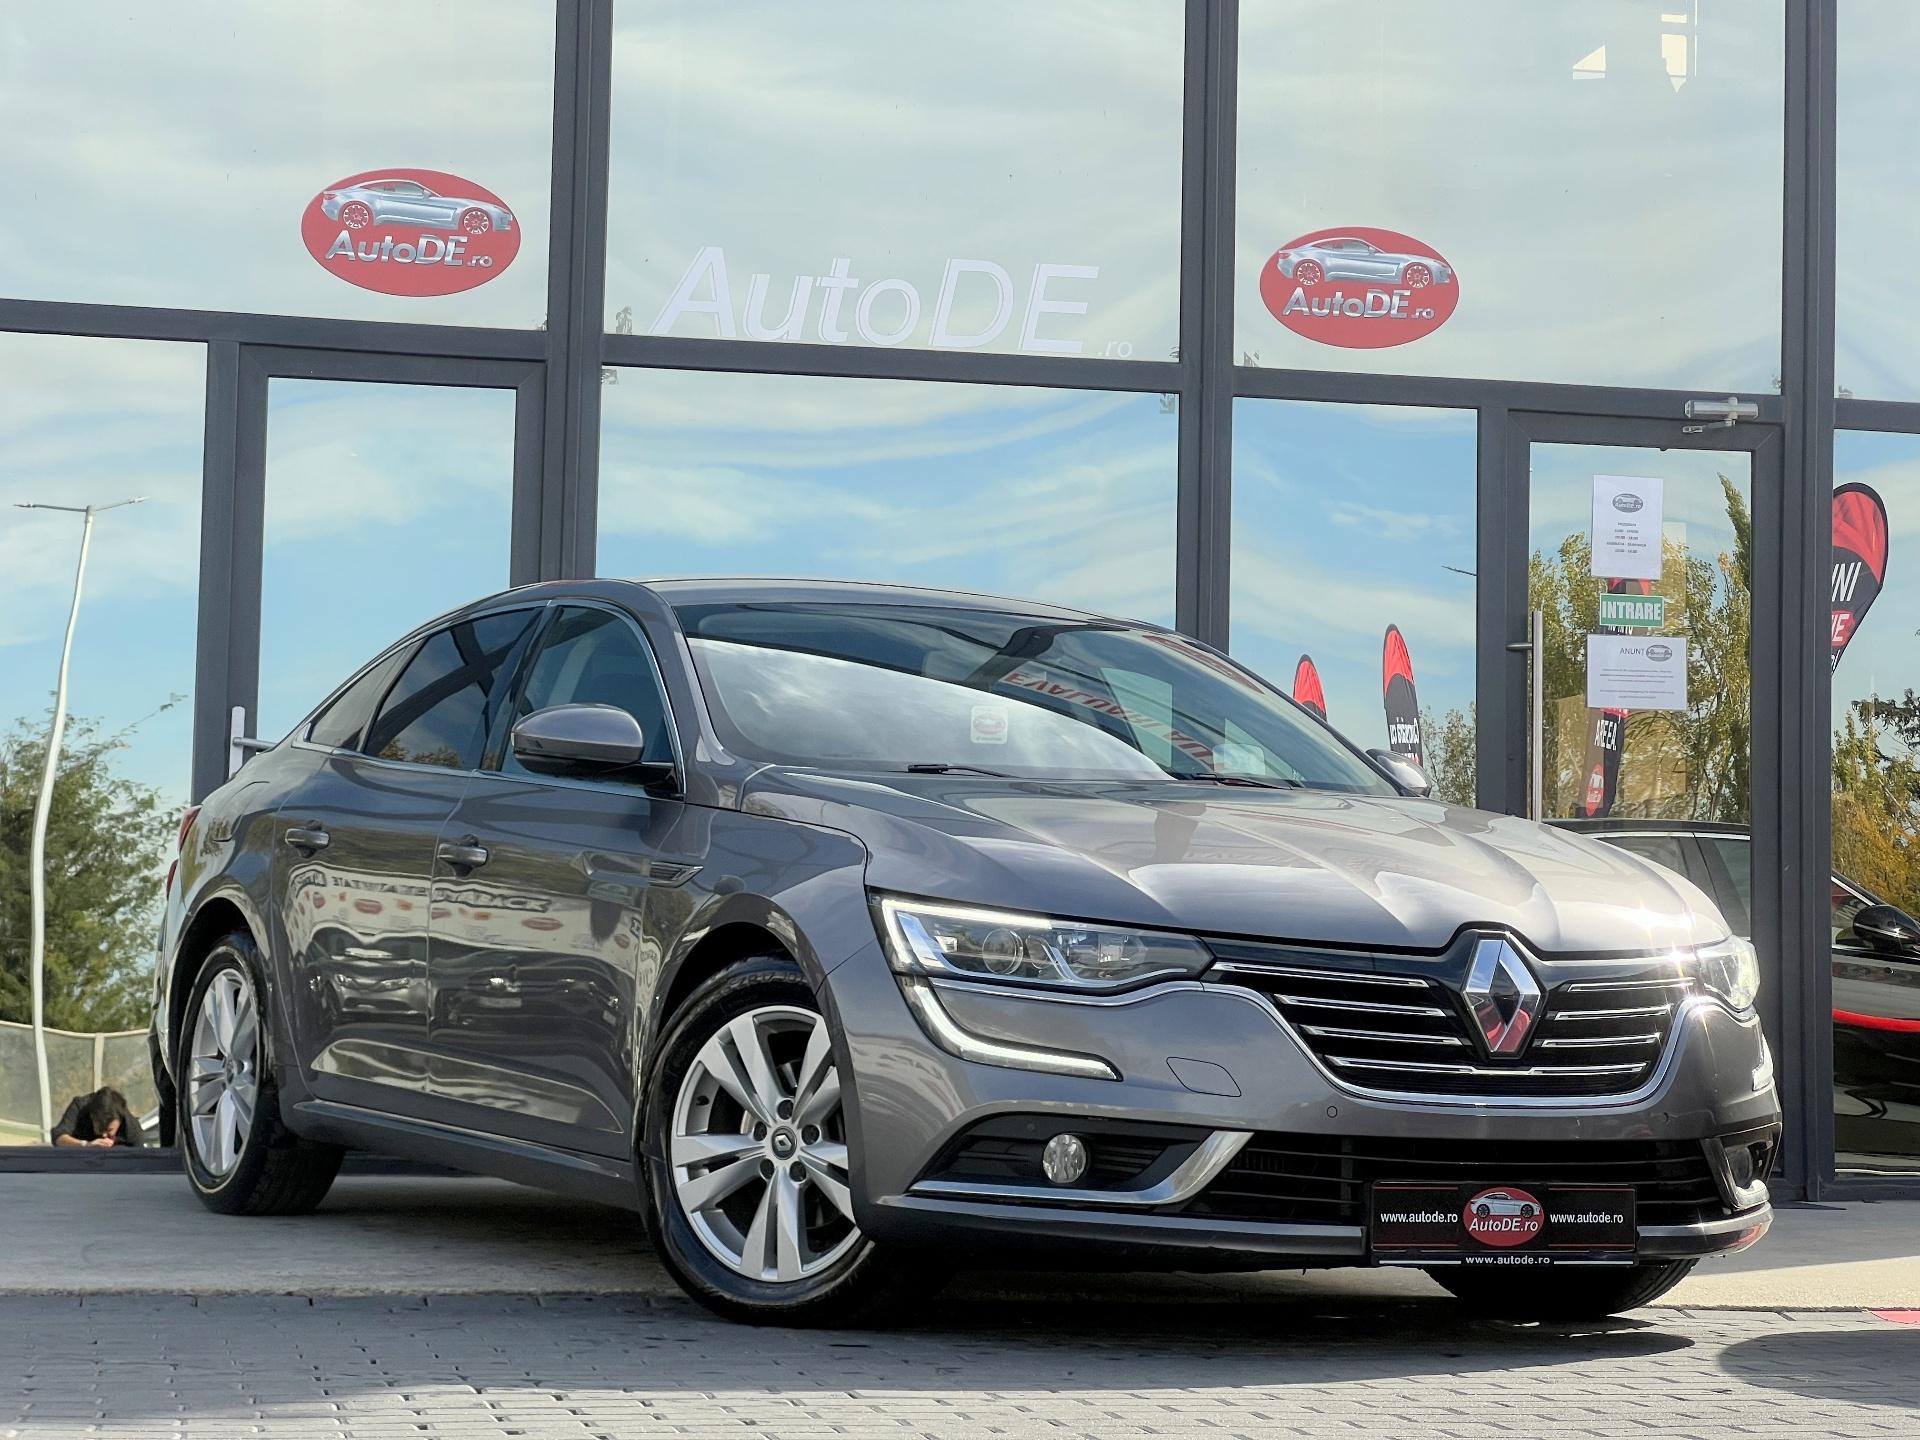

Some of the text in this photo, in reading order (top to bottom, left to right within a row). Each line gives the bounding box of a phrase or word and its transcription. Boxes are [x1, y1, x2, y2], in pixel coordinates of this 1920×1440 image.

[1601, 601, 1662, 622] INTRARE
[1380, 1210, 1458, 1224] www.autode.ro
[1550, 1212, 1624, 1225] www.autode.ro
[1469, 1217, 1539, 1233] AutoDE.ro
[1465, 1254, 1551, 1266] www.autode.ro
